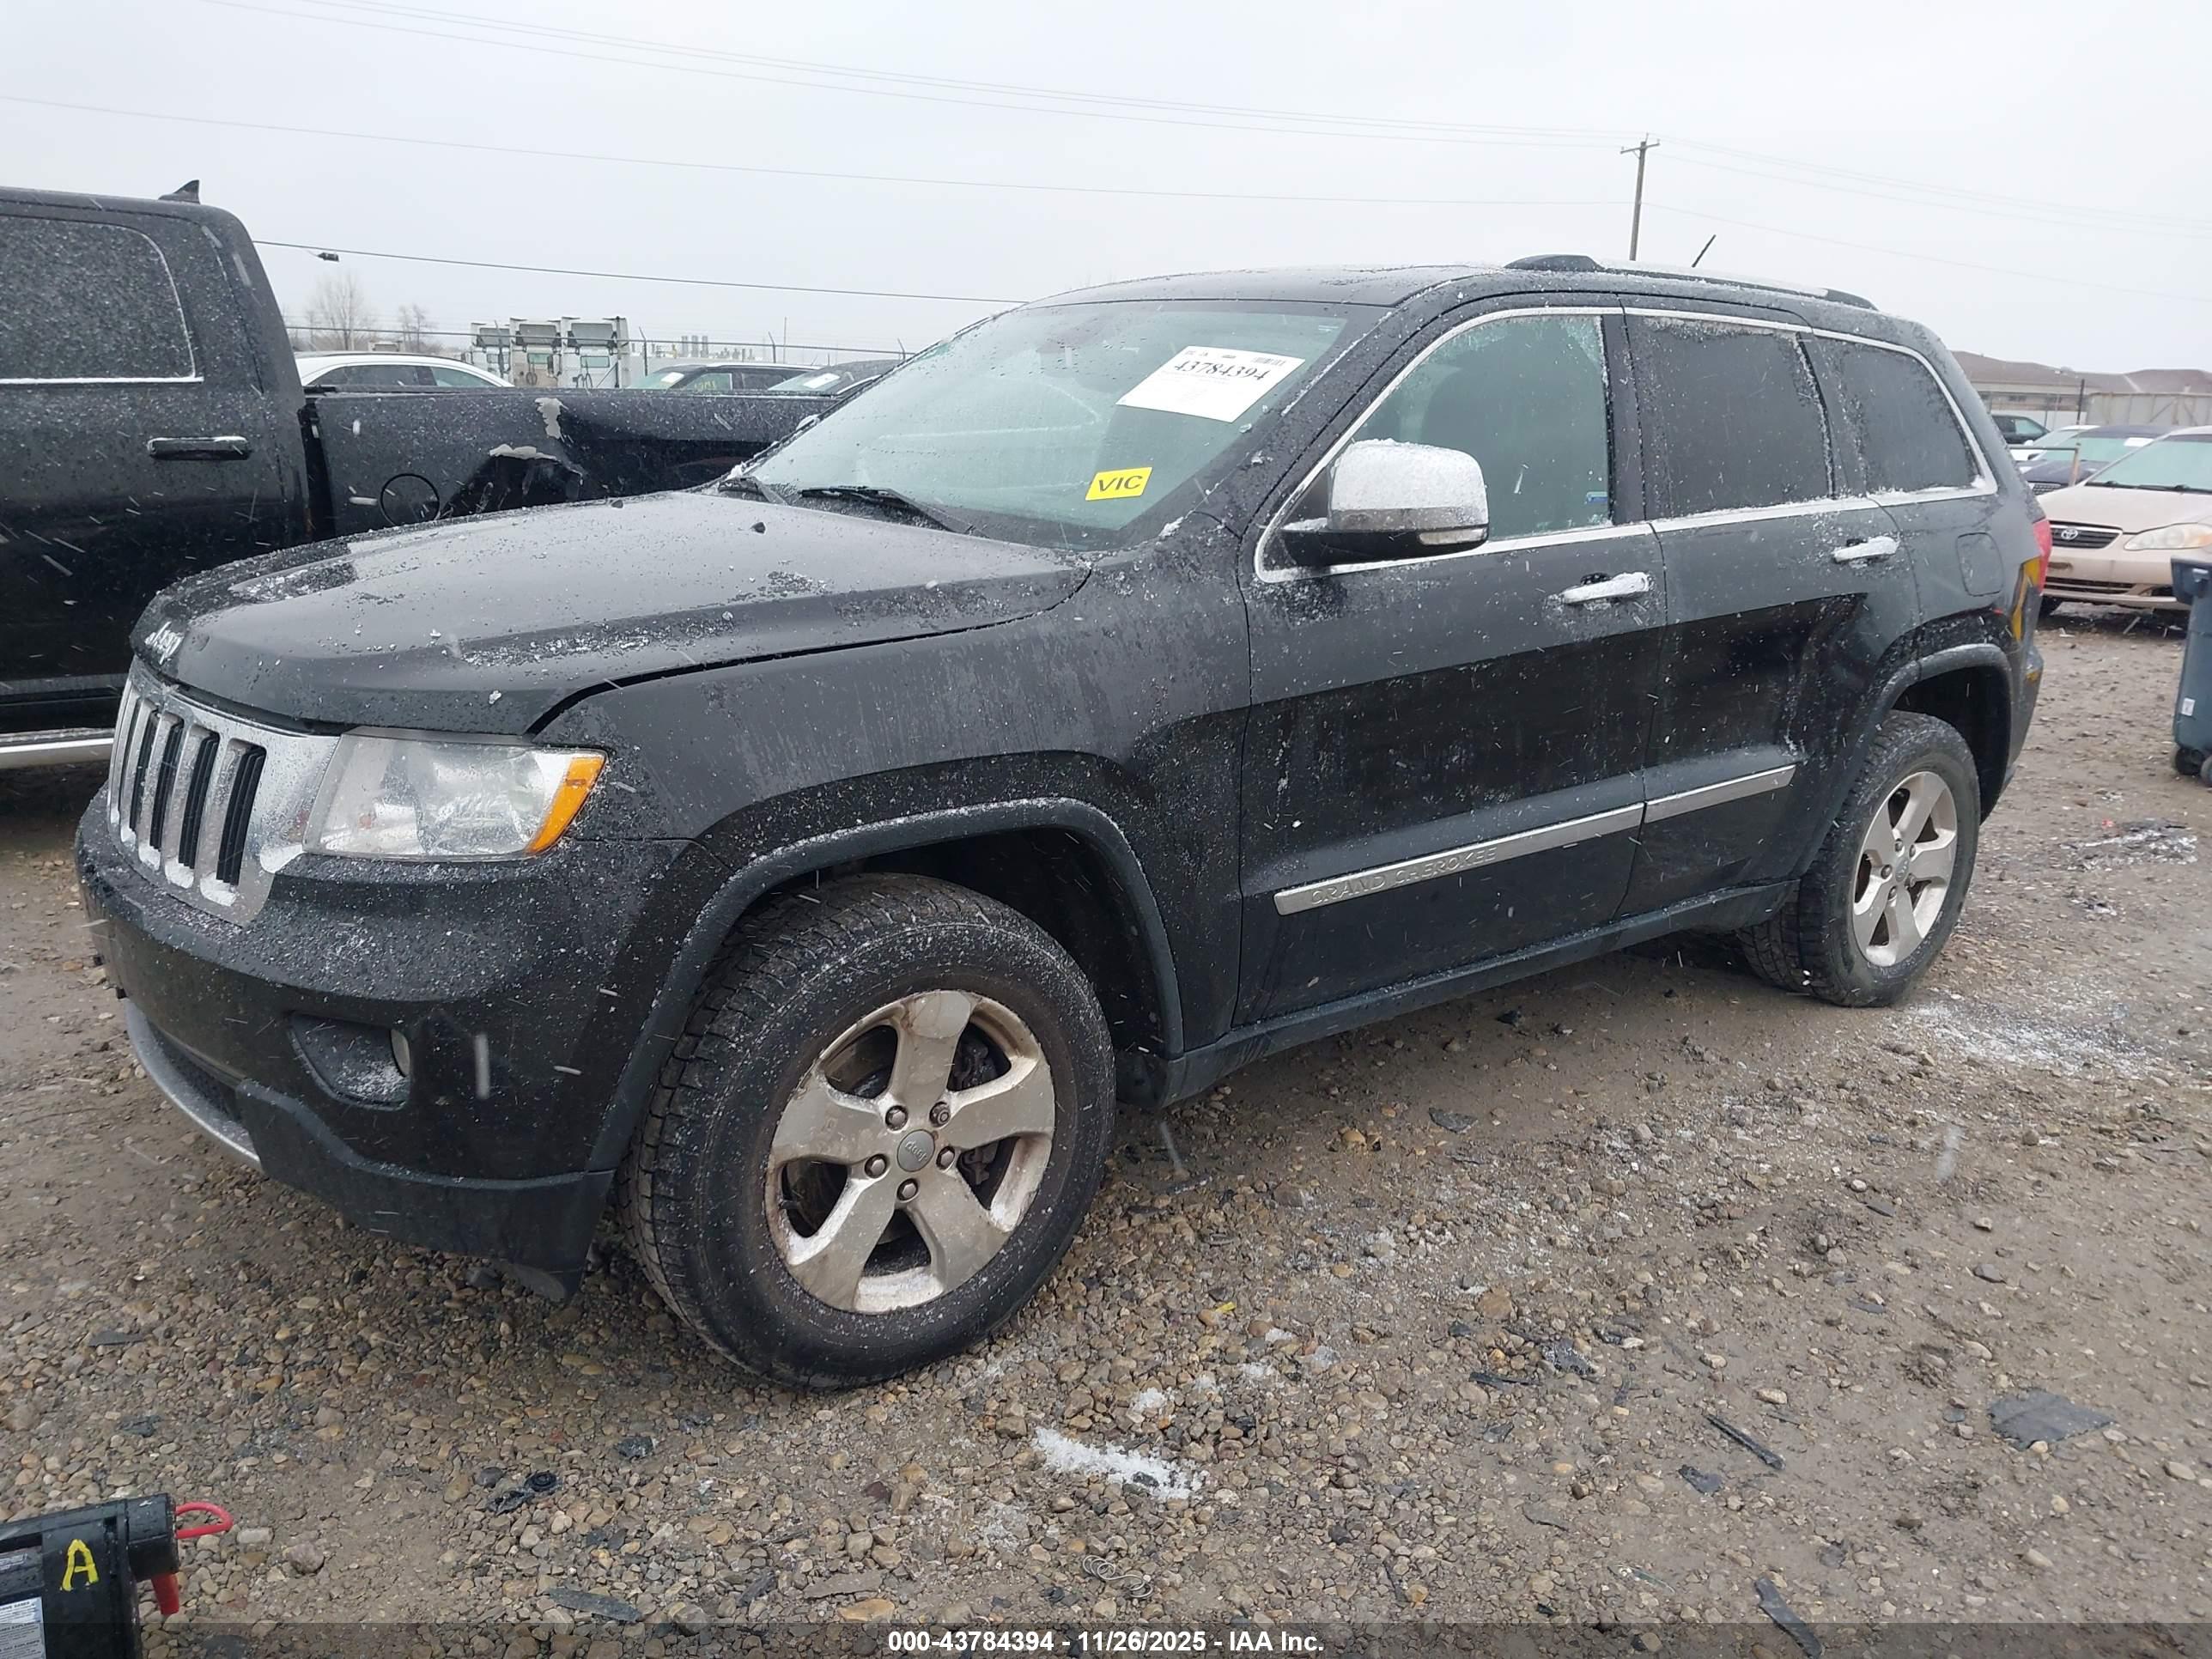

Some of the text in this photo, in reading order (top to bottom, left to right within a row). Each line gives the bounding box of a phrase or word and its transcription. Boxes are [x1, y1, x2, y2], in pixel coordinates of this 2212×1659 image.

[1174, 360, 1272, 380] 43784394
[1098, 475, 1144, 493] VIC
[1311, 846, 1498, 905] GRAND CHEROKEE
[63, 1539, 99, 1591] A
